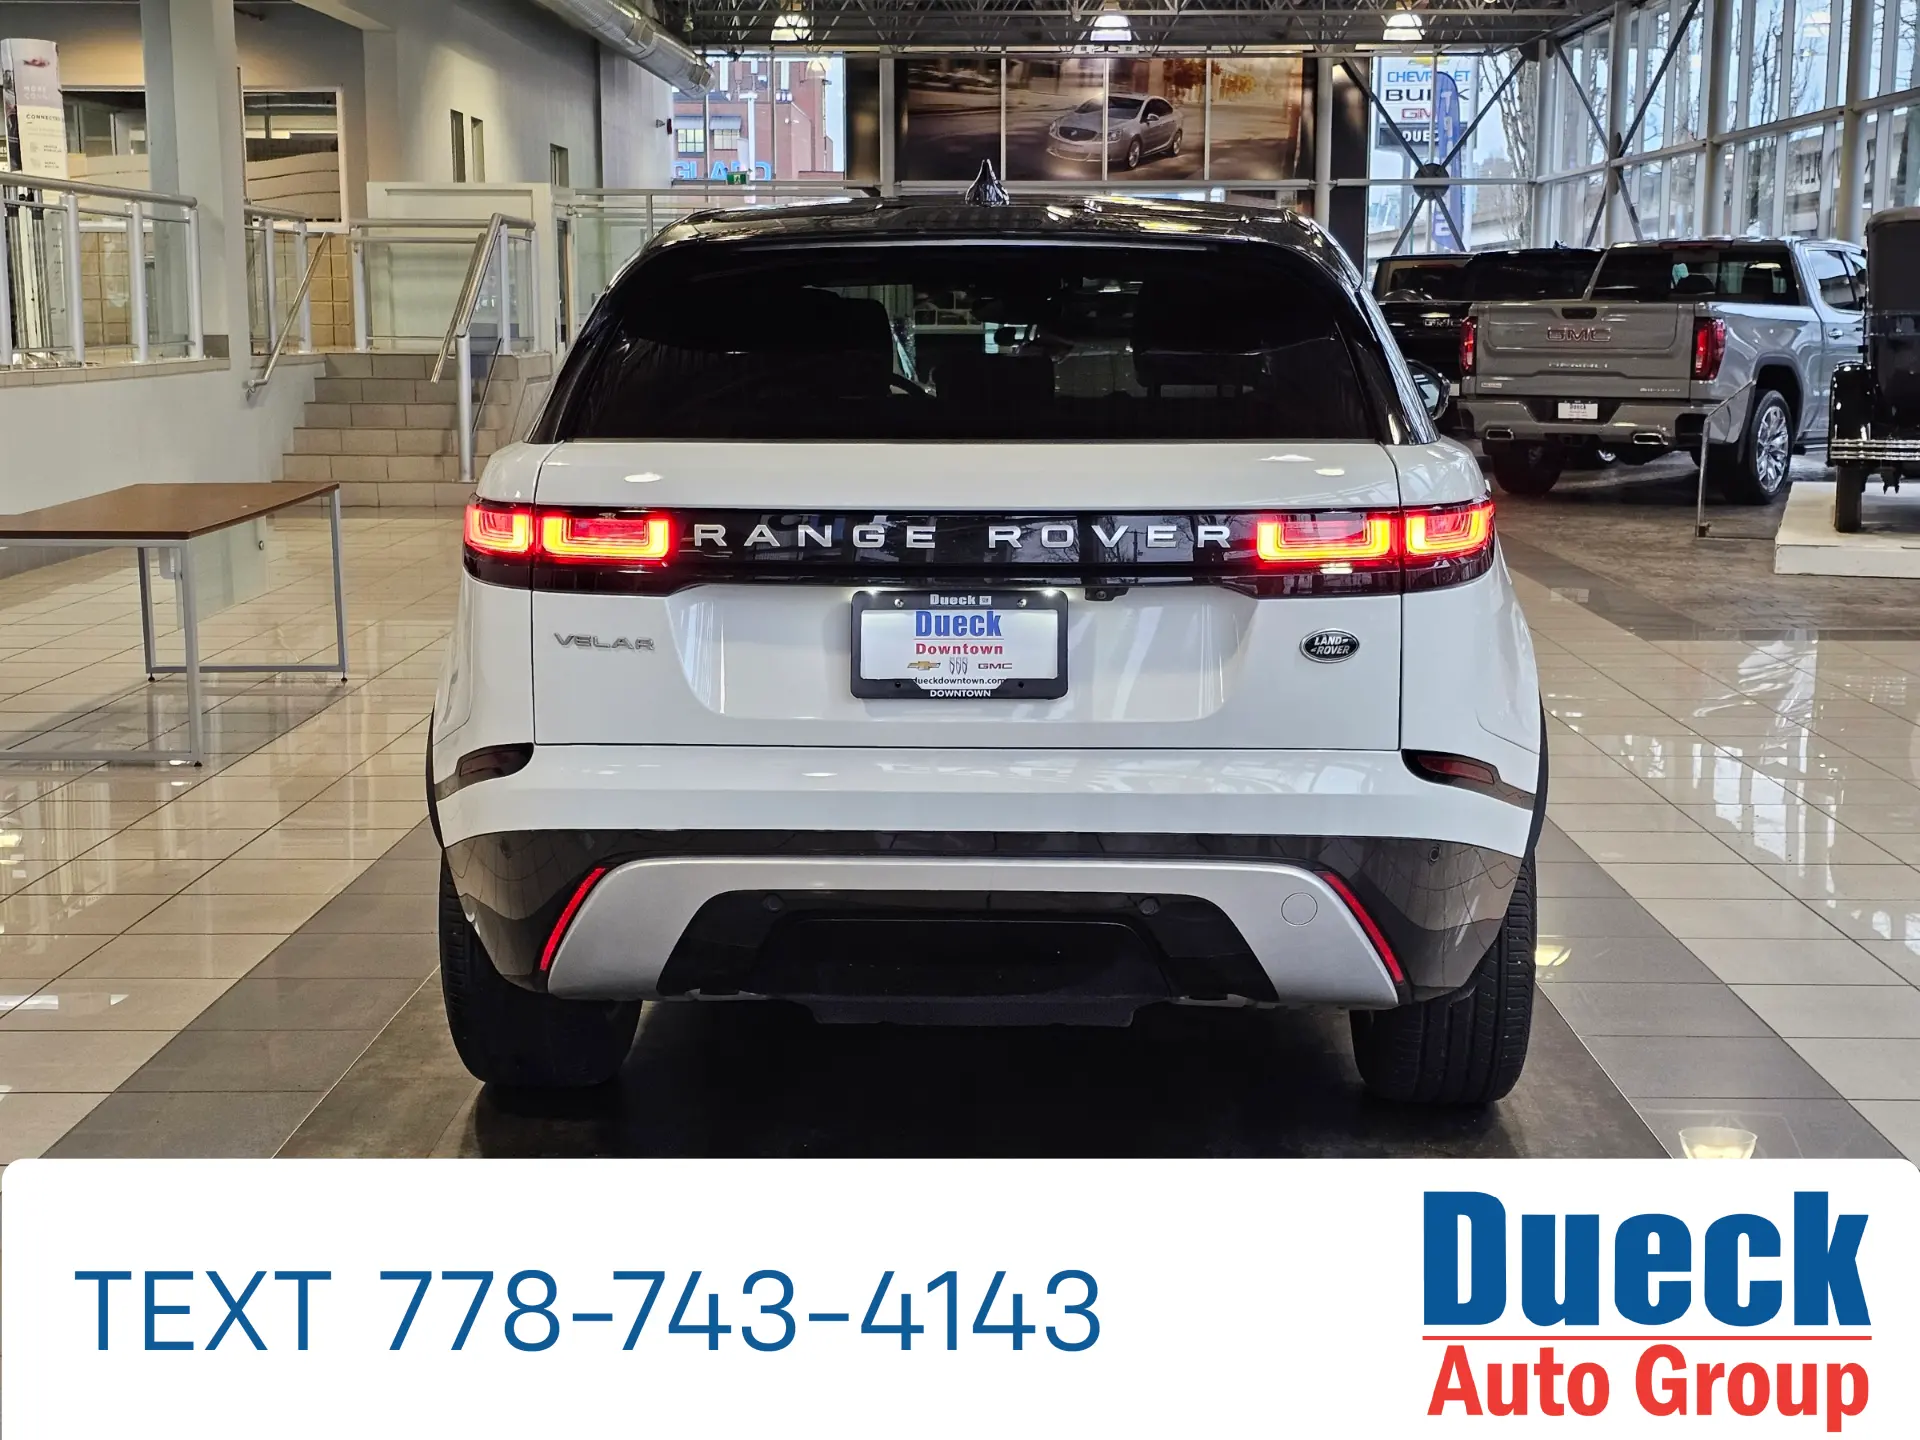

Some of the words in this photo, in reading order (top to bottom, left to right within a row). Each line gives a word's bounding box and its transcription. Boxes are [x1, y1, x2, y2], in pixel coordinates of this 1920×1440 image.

[1385, 88, 1470, 102] BUIK
[1546, 326, 1612, 342] GMC
[693, 524, 937, 549] RANGE
[988, 524, 1231, 549] ROVER
[929, 593, 976, 605] Dueck
[915, 610, 1002, 637] Dueck
[553, 632, 655, 651] VELAR
[1314, 636, 1342, 646] LAND
[915, 643, 1003, 655] Downtown
[1316, 645, 1350, 655] ROVER
[977, 662, 1013, 670] GMC
[929, 689, 991, 697] DOWNTOWN
